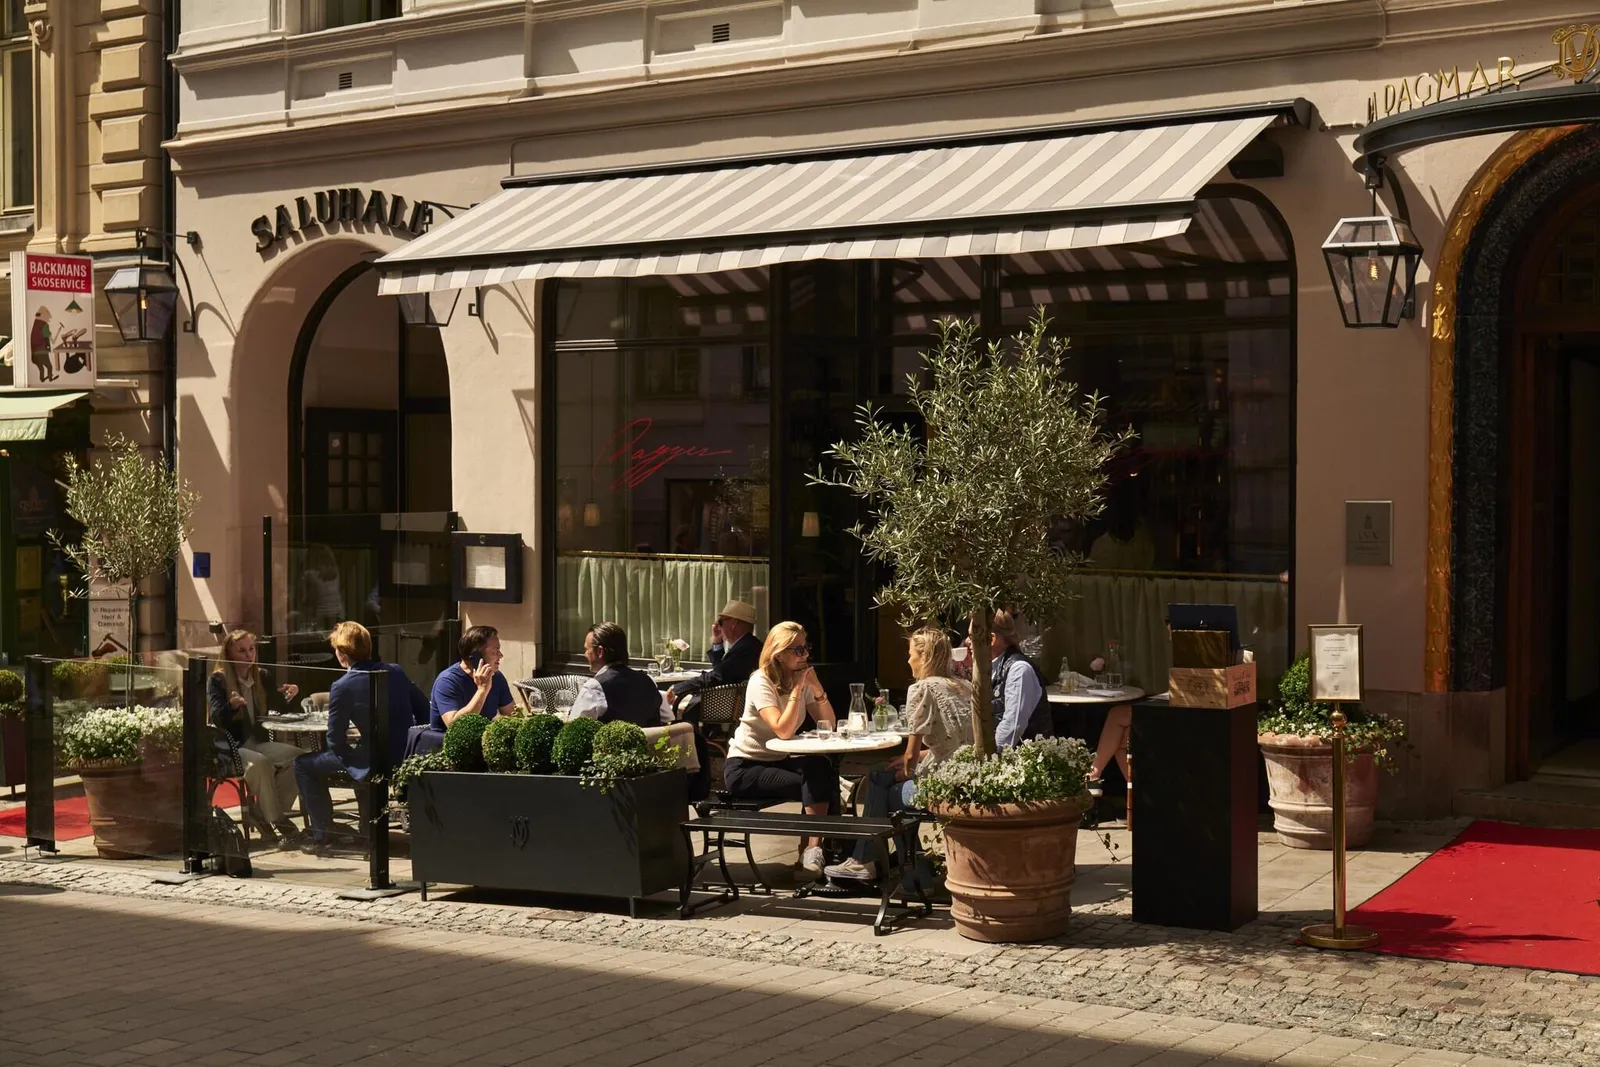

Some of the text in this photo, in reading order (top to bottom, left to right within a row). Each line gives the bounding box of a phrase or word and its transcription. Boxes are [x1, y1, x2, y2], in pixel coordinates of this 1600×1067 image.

[1384, 56, 1520, 115] DAGMAR
[30, 261, 87, 277] BACKMANS
[31, 276, 87, 290] SKOSERVICE
